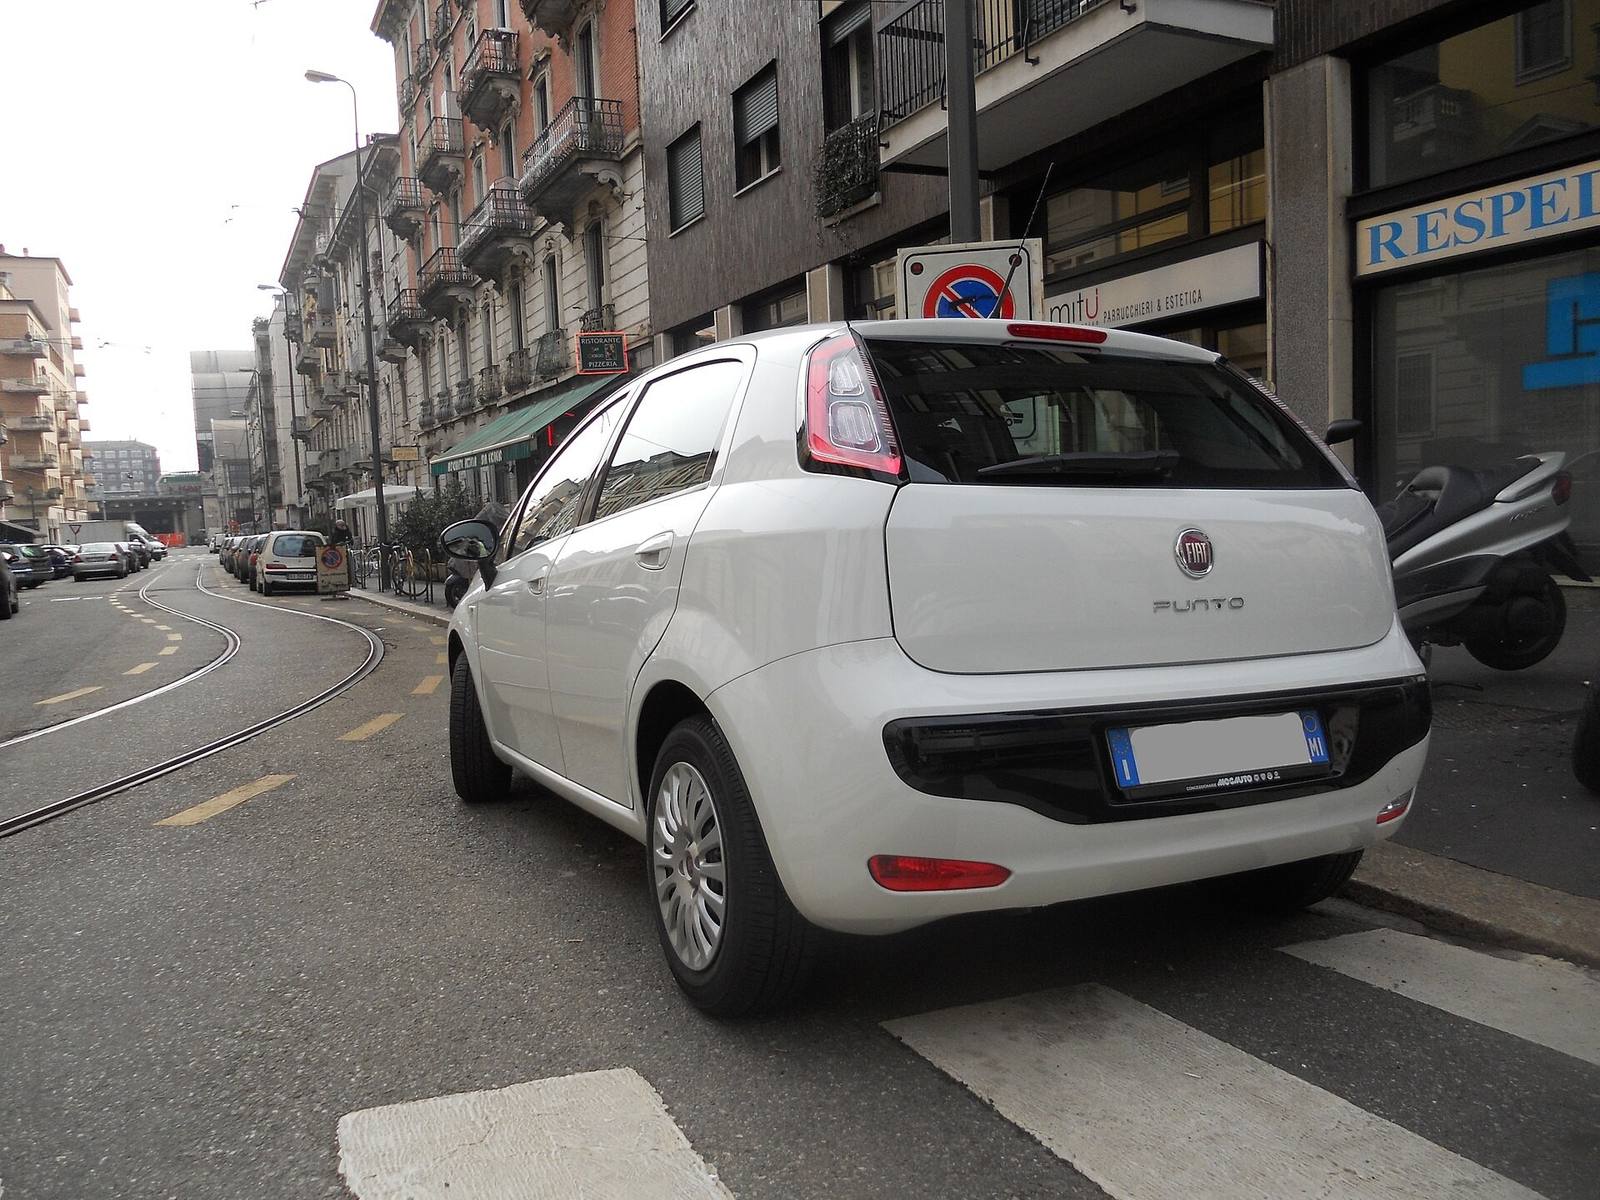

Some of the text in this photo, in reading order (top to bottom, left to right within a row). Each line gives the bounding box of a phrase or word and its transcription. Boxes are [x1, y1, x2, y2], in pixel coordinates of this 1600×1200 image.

[1103, 288, 1203, 324] PARRUCCHIERI & ESTETICA
[1185, 542, 1208, 564] FIAT
[1152, 597, 1245, 614] PUNTO
[1307, 736, 1325, 757] MI
